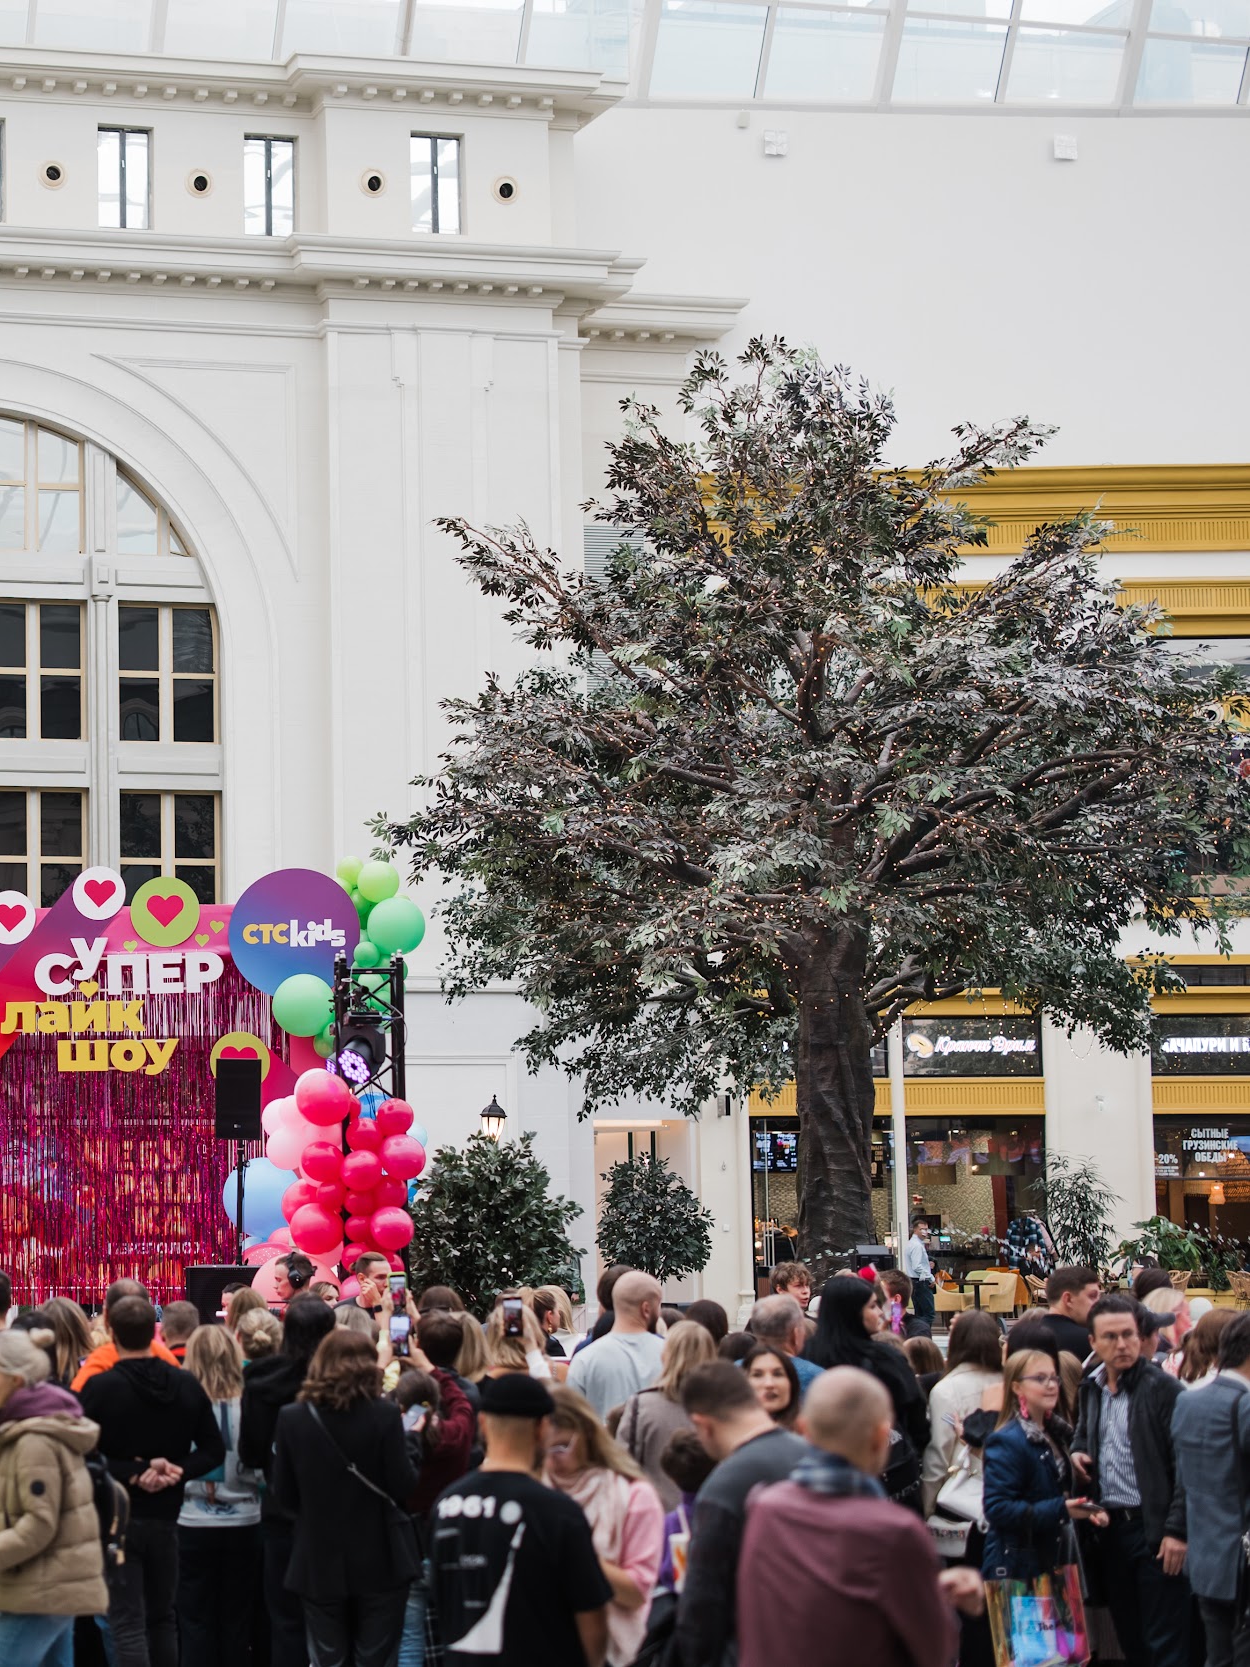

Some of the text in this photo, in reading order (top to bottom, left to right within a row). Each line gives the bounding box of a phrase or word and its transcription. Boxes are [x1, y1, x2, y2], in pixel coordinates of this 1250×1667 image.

[1229, 1037, 1239, 1053] И
[1191, 1128, 1229, 1139] СЫТНЫЕ
[1182, 1140, 1238, 1151] ГРУЗИНСКИЕ
[1194, 1152, 1227, 1163] ОБЕДЫ
